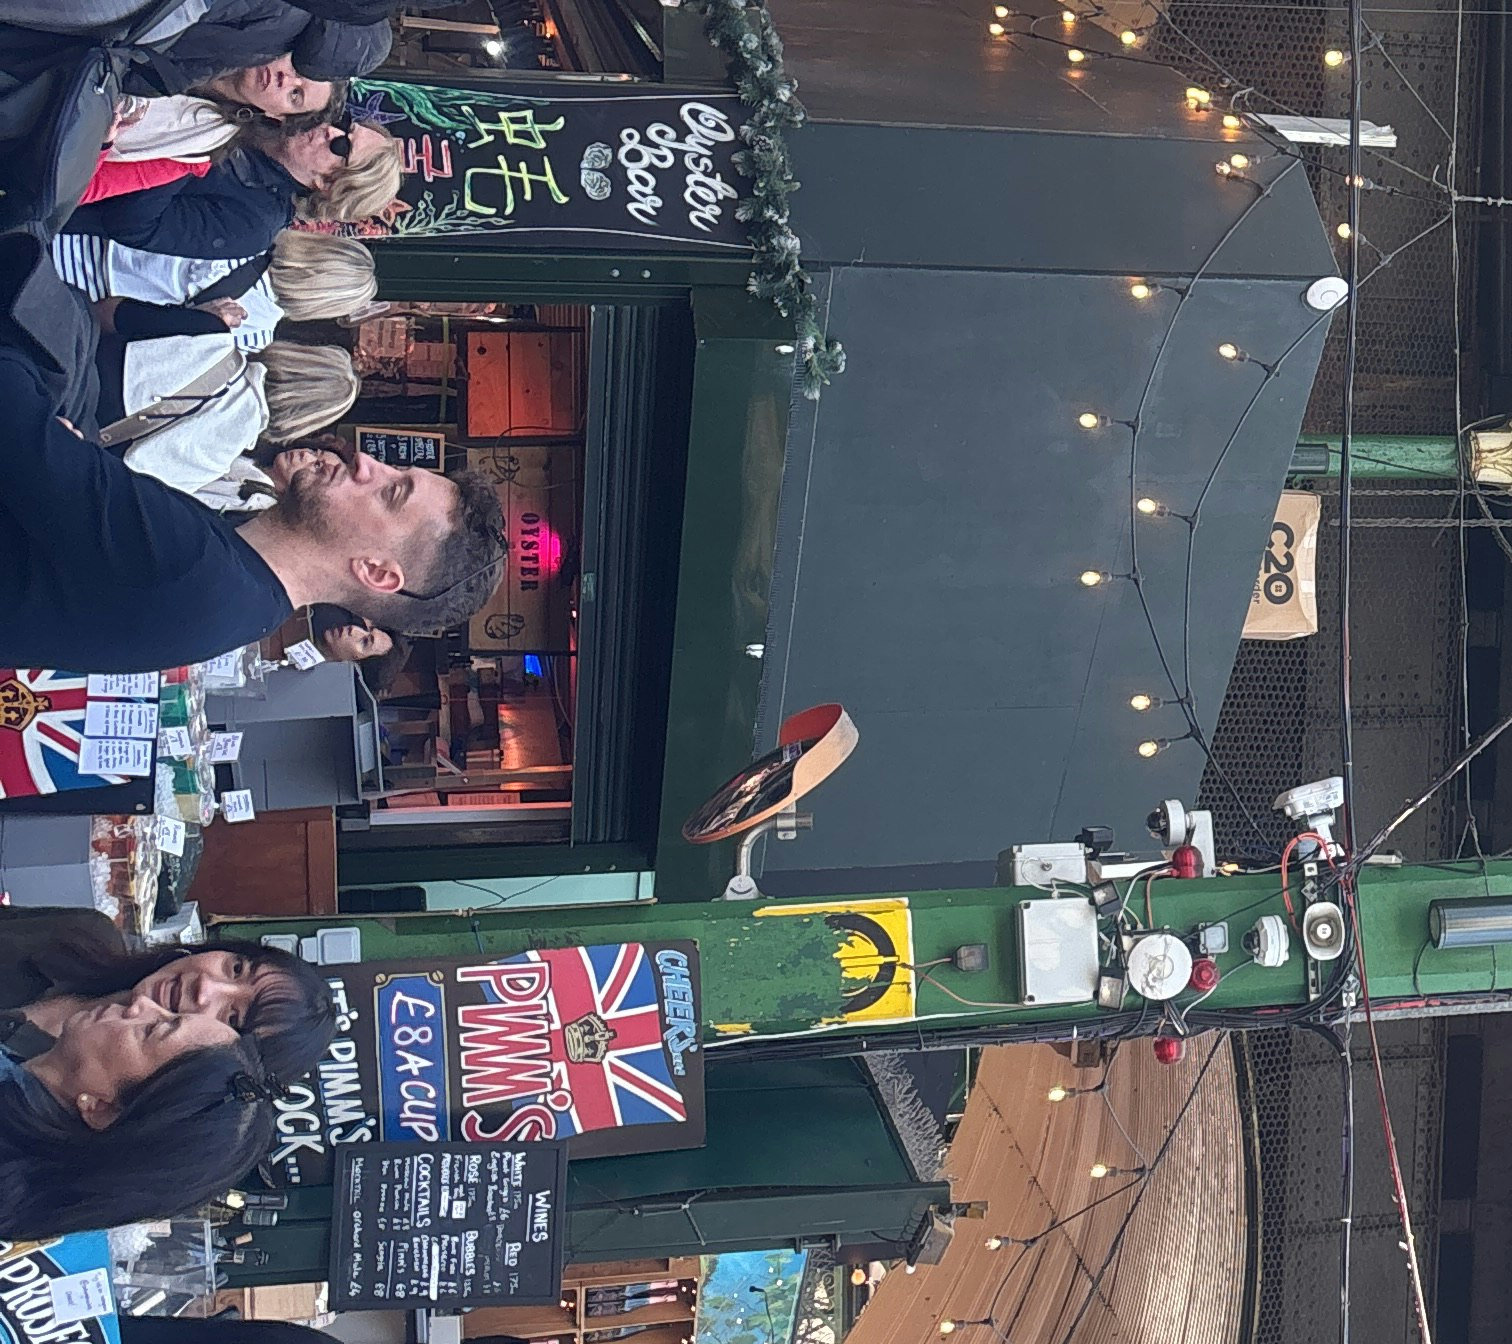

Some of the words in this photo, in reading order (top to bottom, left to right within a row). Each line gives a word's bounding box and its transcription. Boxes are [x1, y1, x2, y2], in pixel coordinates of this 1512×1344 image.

[461, 106, 570, 216] 蚝
[617, 128, 675, 227] Bar
[645, 102, 739, 233] Oyster
[520, 512, 540, 592] OYSTER
[390, 991, 435, 1046] £8
[456, 961, 573, 1143] PIMM'S
[317, 1039, 377, 1148] PIMM'S
[395, 1050, 434, 1076] A
[398, 1080, 439, 1143] CUP
[415, 1153, 435, 1228] COCKTAILS
[512, 1152, 526, 1188] WHITE
[531, 1190, 551, 1243] WINES
[464, 1230, 479, 1277] BUBBLES
[509, 1242, 522, 1267] RED
